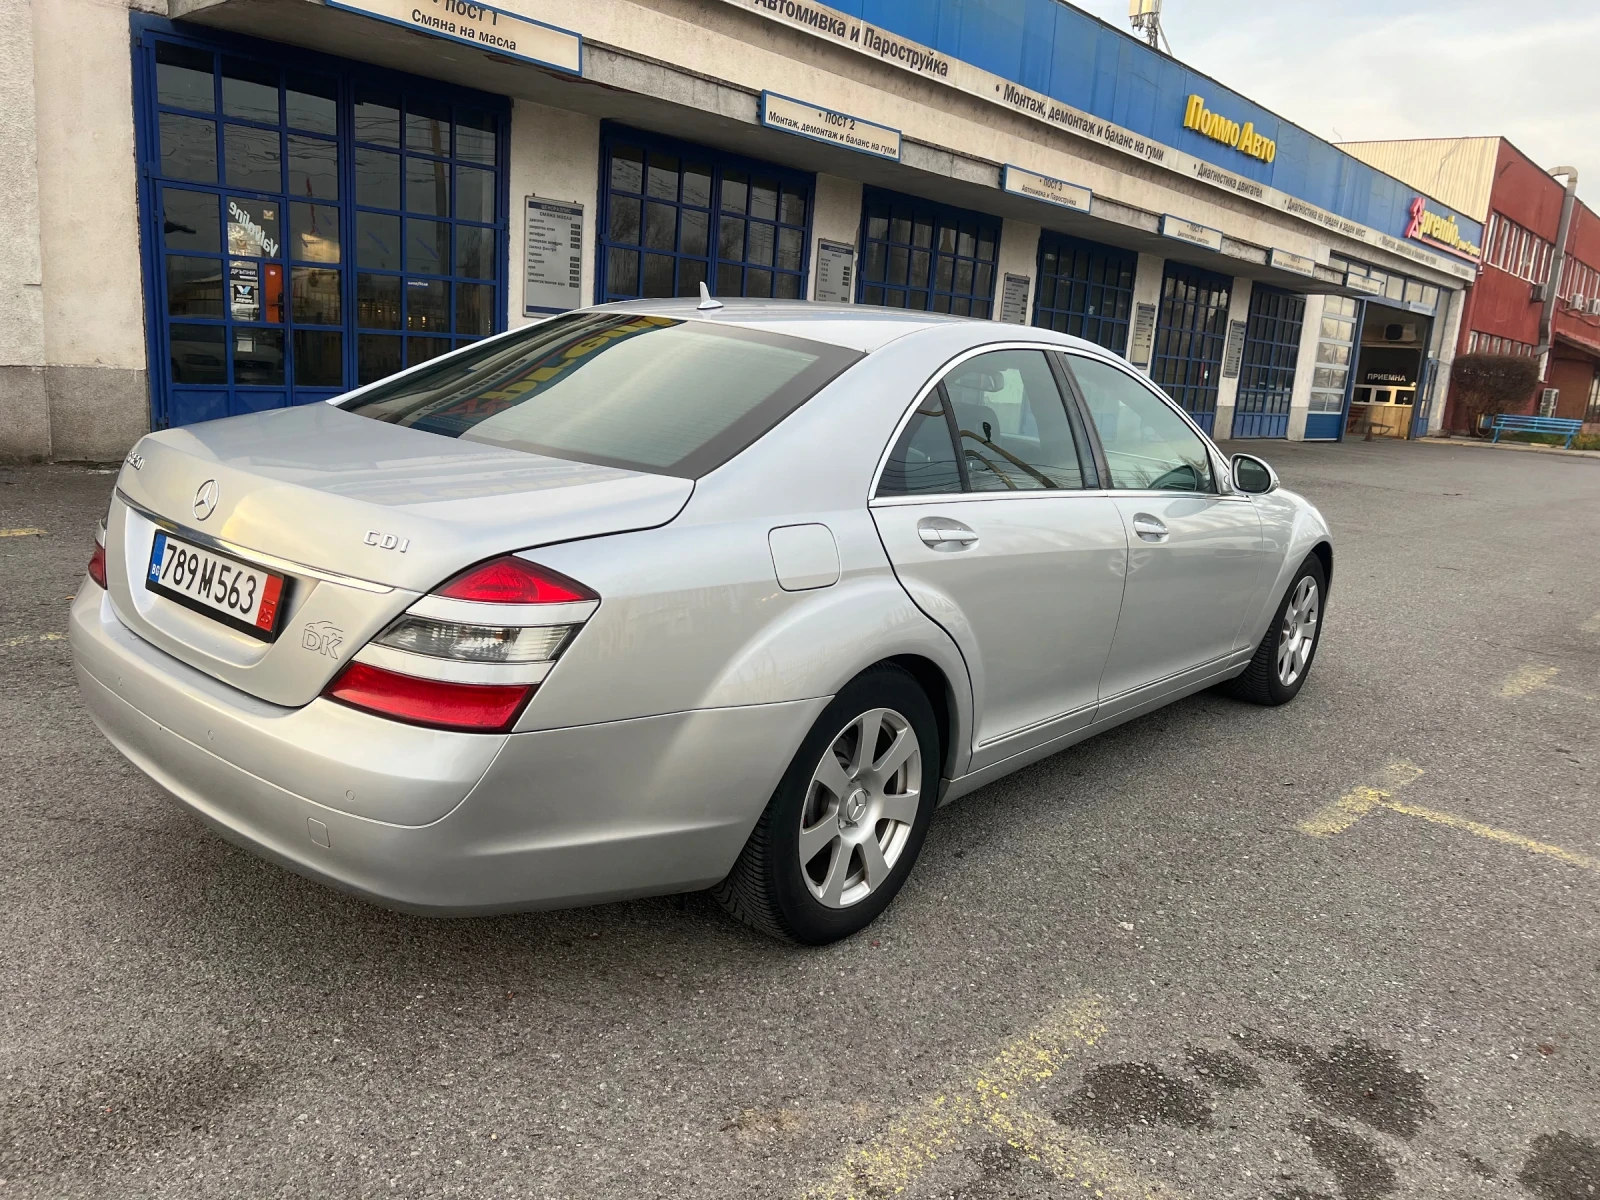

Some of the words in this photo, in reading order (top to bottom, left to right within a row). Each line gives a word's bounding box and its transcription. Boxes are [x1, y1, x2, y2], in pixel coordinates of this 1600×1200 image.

[412, 8, 456, 33] Смяна
[460, 25, 475, 38] на
[479, 31, 516, 50] масла
[445, 0, 486, 22] ПОСТ
[754, 0, 846, 38] втомивка
[850, 26, 860, 42] и
[863, 27, 948, 77] Пароструйка
[768, 111, 800, 130] Монтаж,
[801, 124, 838, 139] демонтаж
[846, 134, 870, 147] баланс
[870, 142, 880, 151] на
[880, 145, 897, 156] гуми
[825, 111, 849, 128] ПОСТ
[849, 119, 856, 131] 2
[1003, 83, 1046, 118] Монтаж,
[1048, 106, 1096, 135] демонтаж
[1096, 125, 1103, 138] и
[1104, 124, 1134, 149] баланс
[1134, 140, 1145, 154] на
[1145, 145, 1164, 162] гуми
[1196, 163, 1237, 189] Диагностика
[1236, 181, 1263, 199] двигател
[1418, 209, 1459, 246] premio
[1367, 373, 1407, 382] ПРИЕМНА
[363, 529, 410, 554] CDI
[151, 563, 161, 576] BG
[161, 543, 257, 614] 789M563
